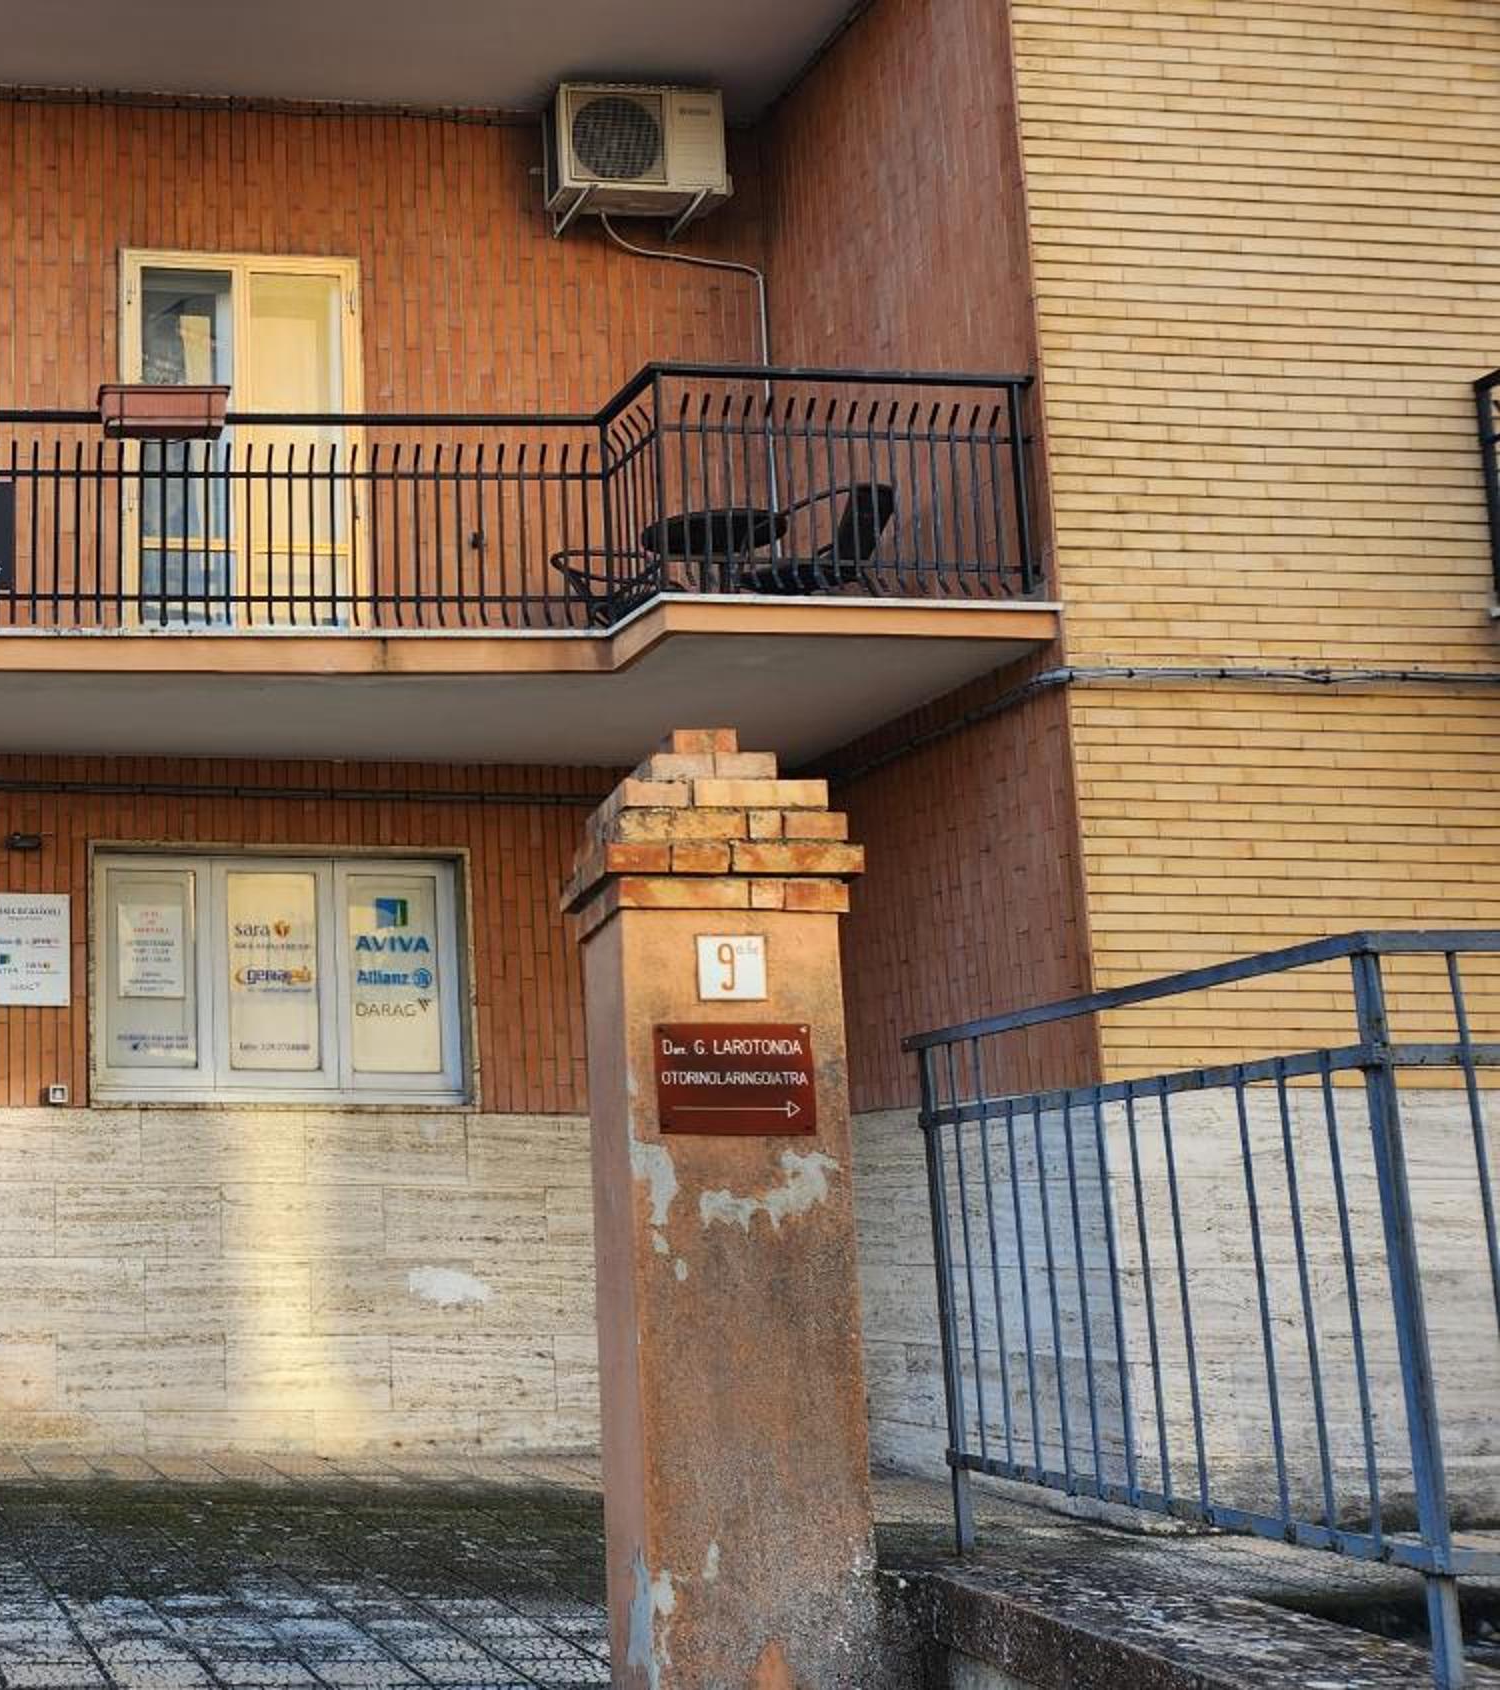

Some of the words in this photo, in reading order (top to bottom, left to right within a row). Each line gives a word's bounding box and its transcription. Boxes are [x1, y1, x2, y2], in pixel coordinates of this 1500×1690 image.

[356, 935, 430, 953] AVIVA
[717, 943, 736, 991] 9
[357, 969, 410, 985] Allianz
[356, 1003, 417, 1017] DARAG
[693, 1039, 709, 1055] G.
[713, 1039, 803, 1055] LAROTONDA
[661, 1071, 809, 1086] OTORINOLARINGOIATRA
